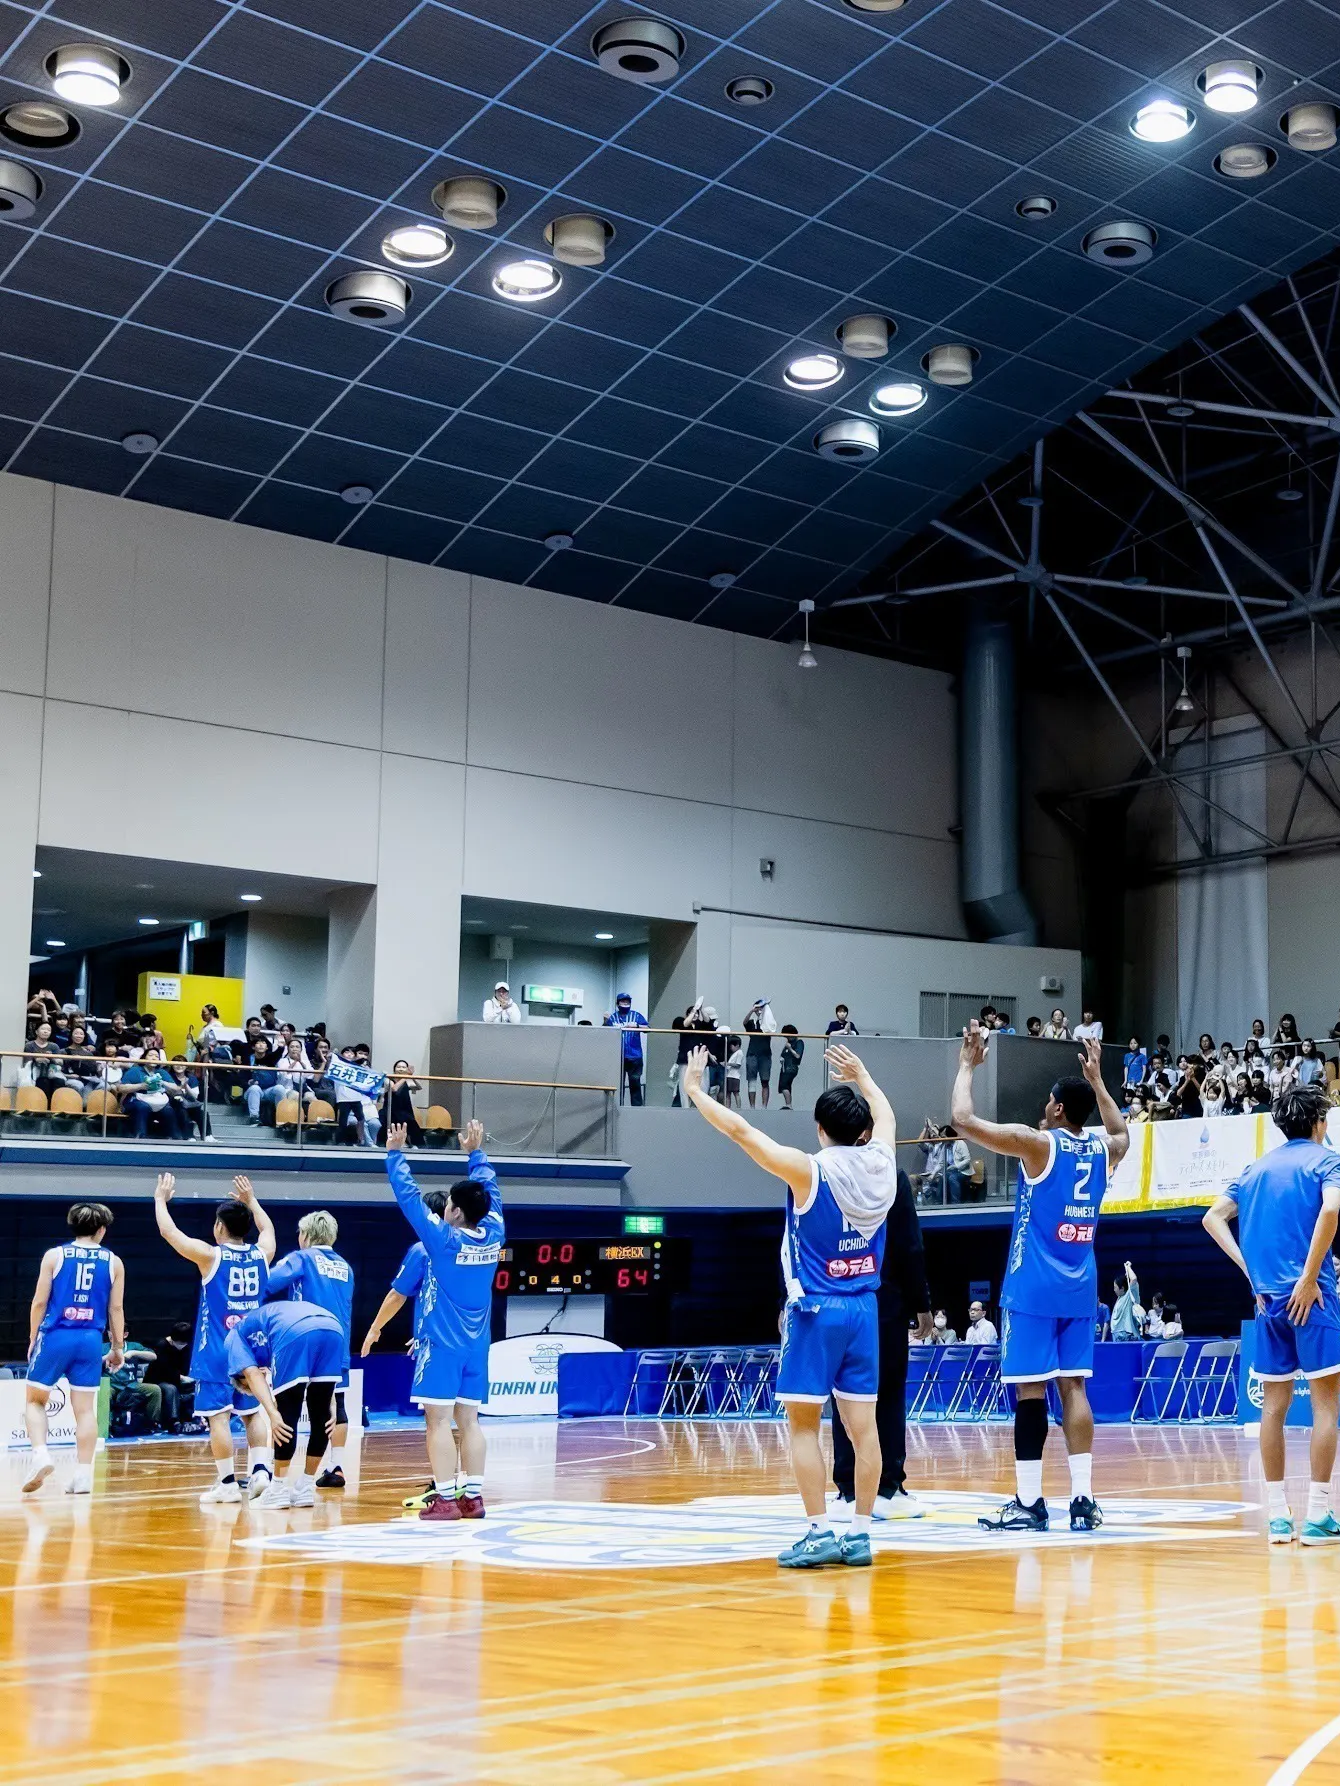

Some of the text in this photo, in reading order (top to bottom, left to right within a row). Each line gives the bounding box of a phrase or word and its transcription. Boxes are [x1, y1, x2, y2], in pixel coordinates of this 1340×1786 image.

[1073, 1162, 1093, 1201] 2
[537, 1244, 574, 1264] 0.0
[838, 1236, 869, 1252] UCHIDA
[75, 1262, 96, 1291] 16
[227, 1265, 260, 1297] 88
[617, 1268, 649, 1288] 64
[487, 1380, 537, 1396] ONAN
[10, 1426, 77, 1440] sakaw
